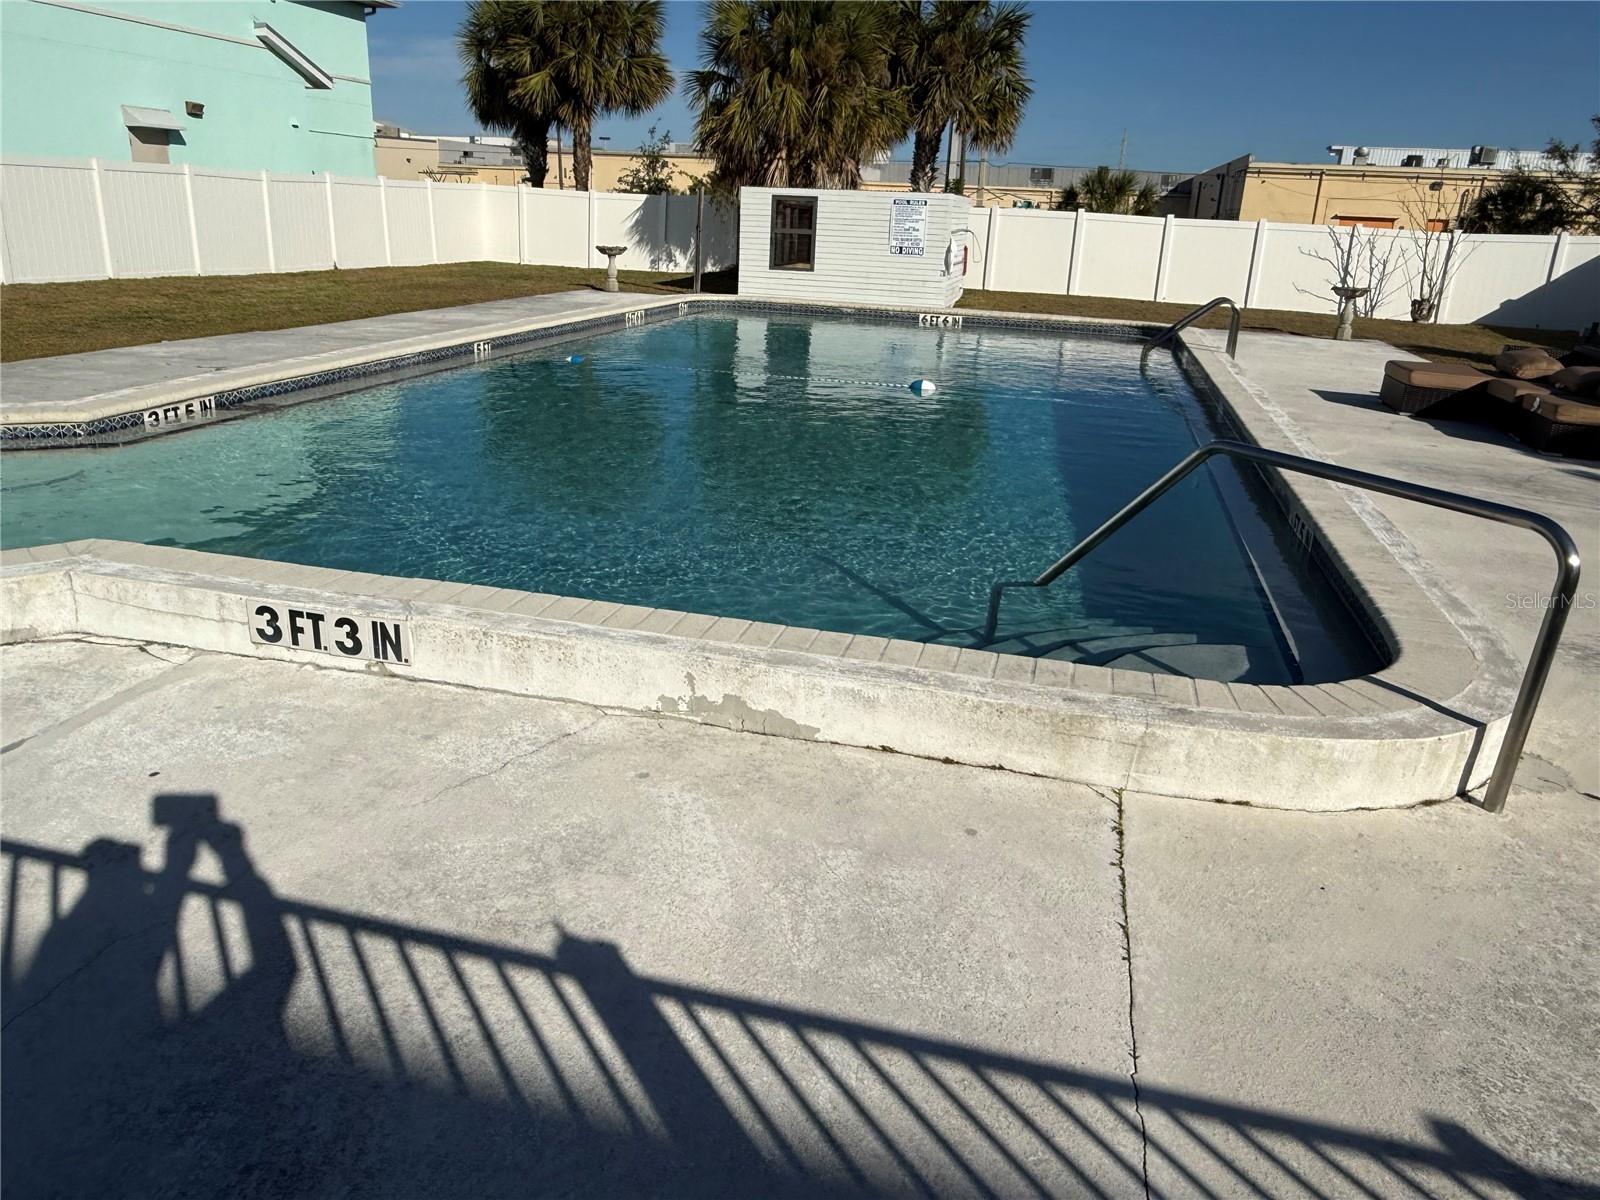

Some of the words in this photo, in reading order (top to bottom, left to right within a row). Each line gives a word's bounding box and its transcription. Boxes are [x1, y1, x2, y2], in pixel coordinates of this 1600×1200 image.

[891, 246, 900, 254] NO
[902, 247, 923, 255] DIVING
[148, 410, 160, 427] 3
[199, 398, 213, 417] IN
[255, 605, 283, 643] 3
[288, 609, 328, 651] FT.
[334, 617, 363, 656] 3
[371, 621, 409, 663] IN.
